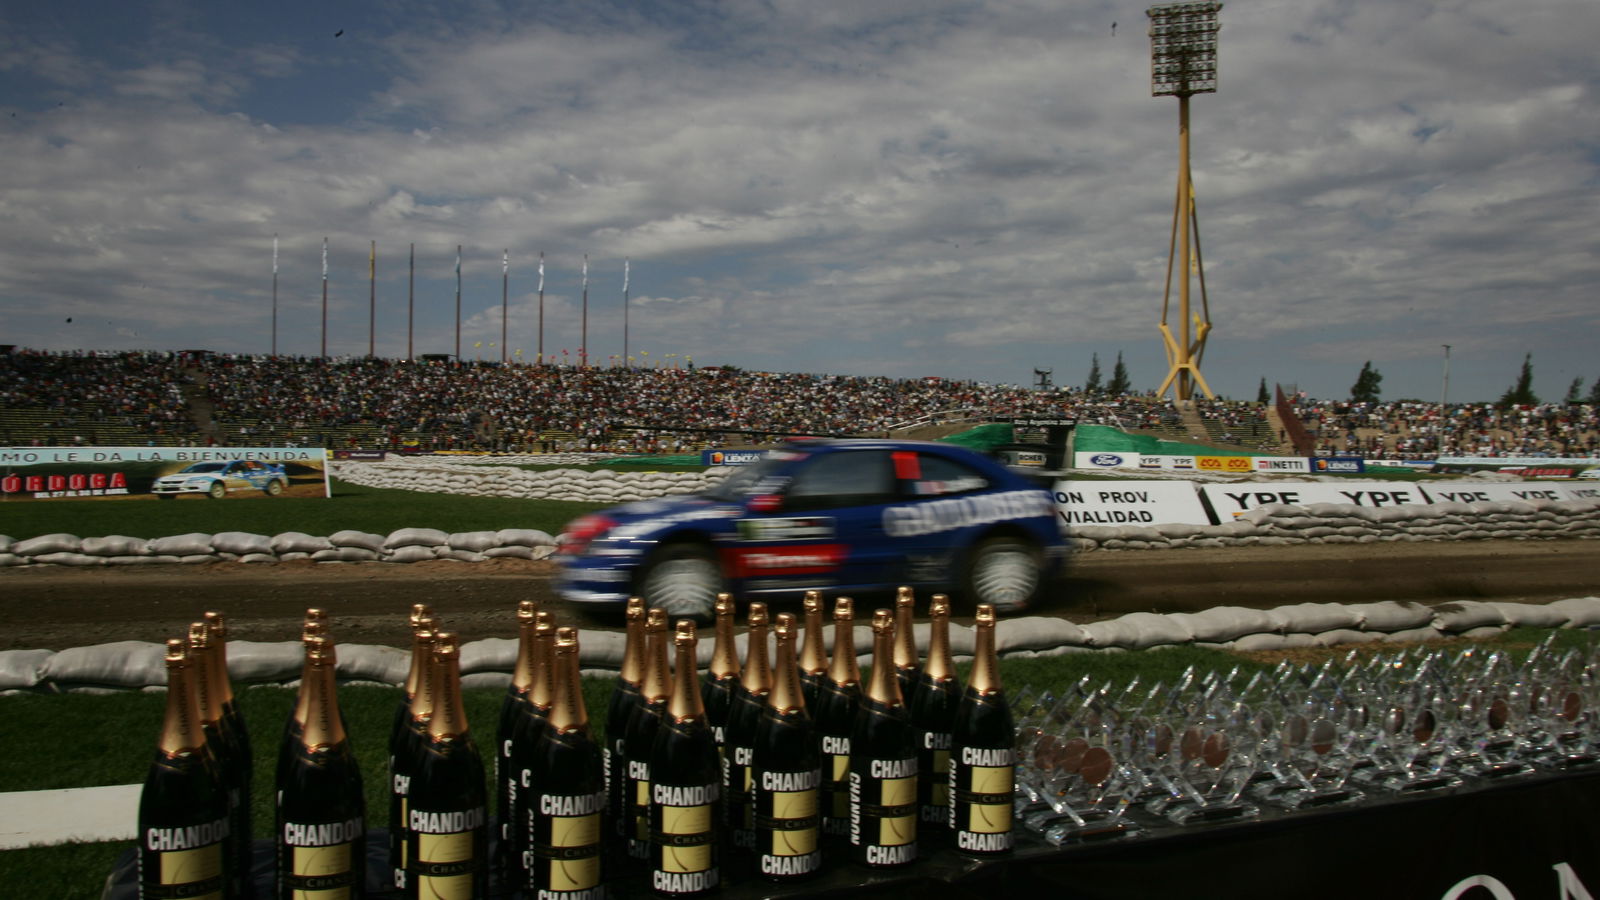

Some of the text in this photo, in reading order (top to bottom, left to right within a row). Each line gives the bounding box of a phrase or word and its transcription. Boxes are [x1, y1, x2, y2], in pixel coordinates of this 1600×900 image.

[54, 453, 78, 462] LE
[94, 452, 122, 461] DA
[137, 452, 163, 461] LA
[176, 452, 310, 461] BIENVENIDA
[1094, 455, 1119, 465] Ford
[1099, 491, 1155, 503] PROV.
[1059, 511, 1153, 523] VIALIDAD
[848, 771, 861, 846] CHANDON
